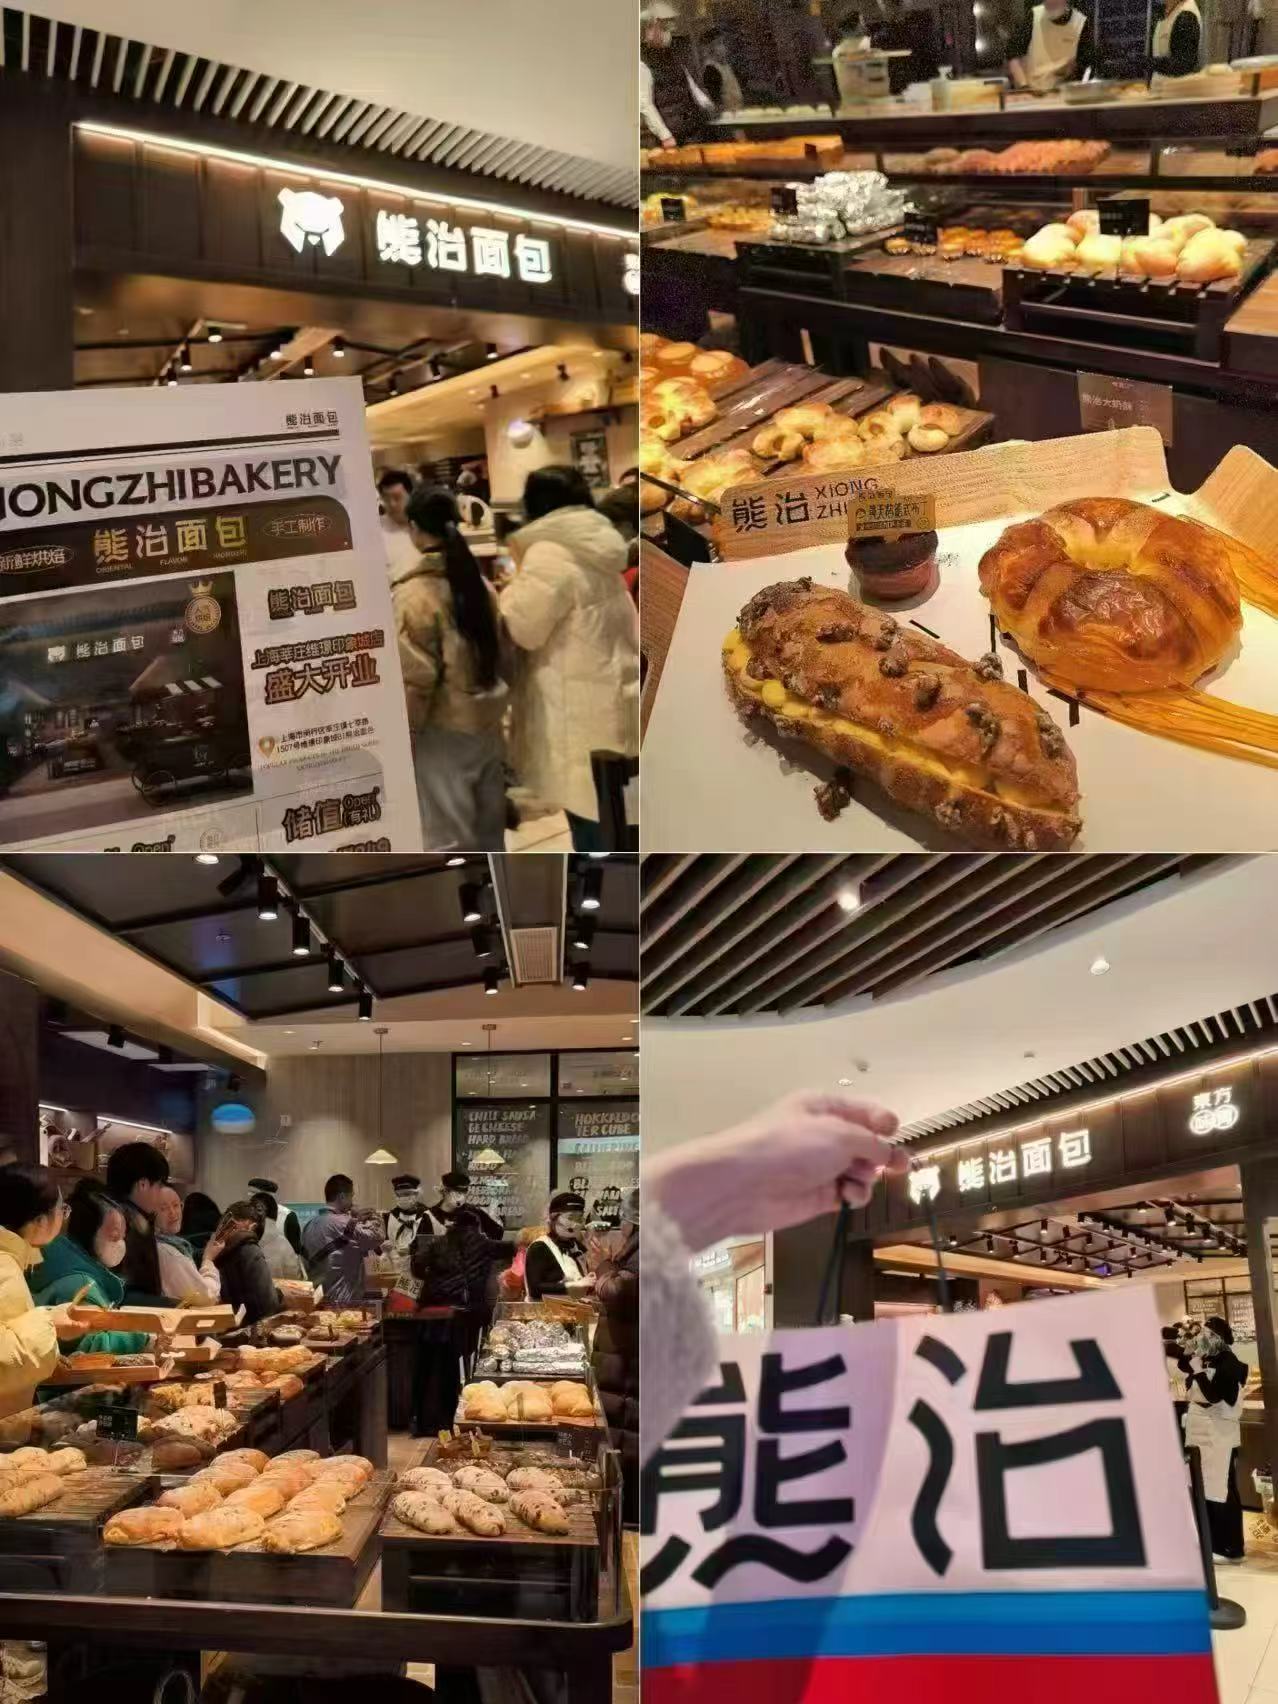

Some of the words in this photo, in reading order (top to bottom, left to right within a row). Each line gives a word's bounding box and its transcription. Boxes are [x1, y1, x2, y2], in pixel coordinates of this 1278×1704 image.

[376, 209, 553, 284] 熊治面包
[286, 411, 339, 426] 熊治面包
[815, 477, 880, 501] XIONG
[271, 517, 327, 537] 手工制作
[731, 490, 811, 534] 熊治
[94, 515, 247, 565] 熊治面包
[267, 580, 357, 613] 熊治面包
[76, 635, 145, 659] 熊治面包
[265, 653, 380, 705] 盛大开业
[283, 799, 342, 843] 储值
[957, 1128, 1093, 1192] 熊治面包
[640, 1332, 1148, 1594] 熊治
